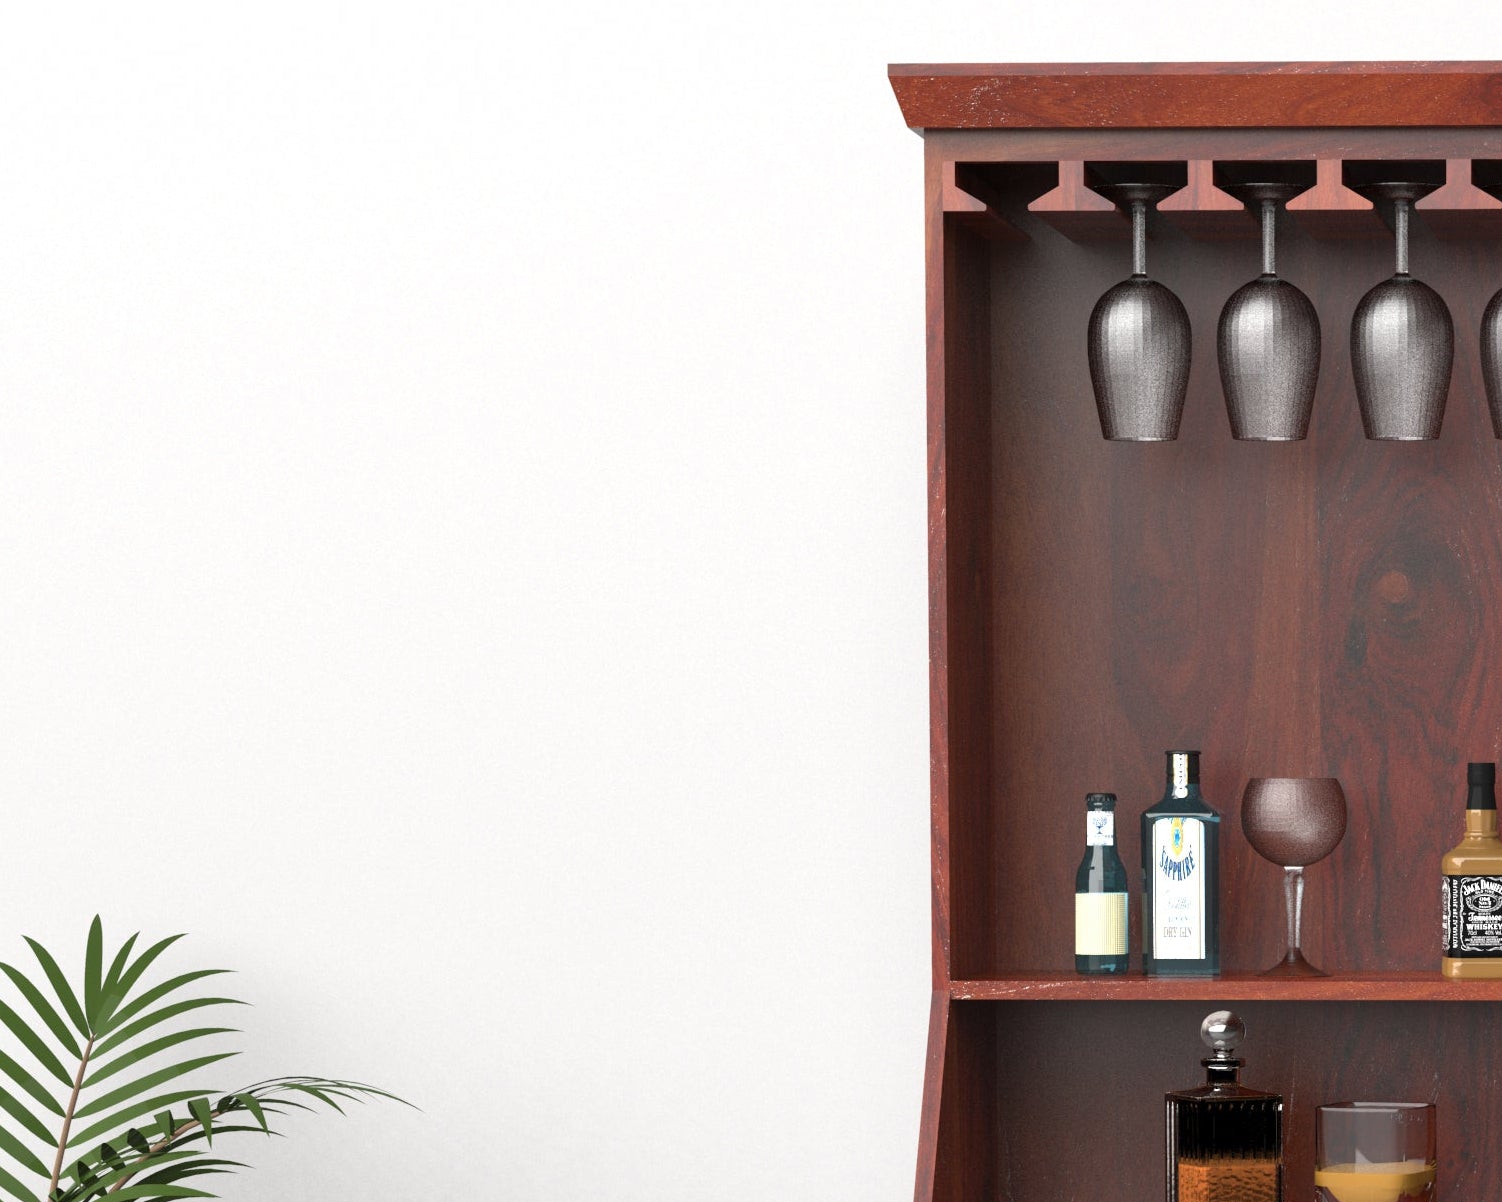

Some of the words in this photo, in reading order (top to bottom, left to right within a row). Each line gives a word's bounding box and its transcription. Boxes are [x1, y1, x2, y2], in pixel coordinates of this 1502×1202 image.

[1159, 847, 1195, 881] SAPPHIRE
[1463, 882, 1480, 896] JACK
[1468, 912, 1502, 921] Tennessee
